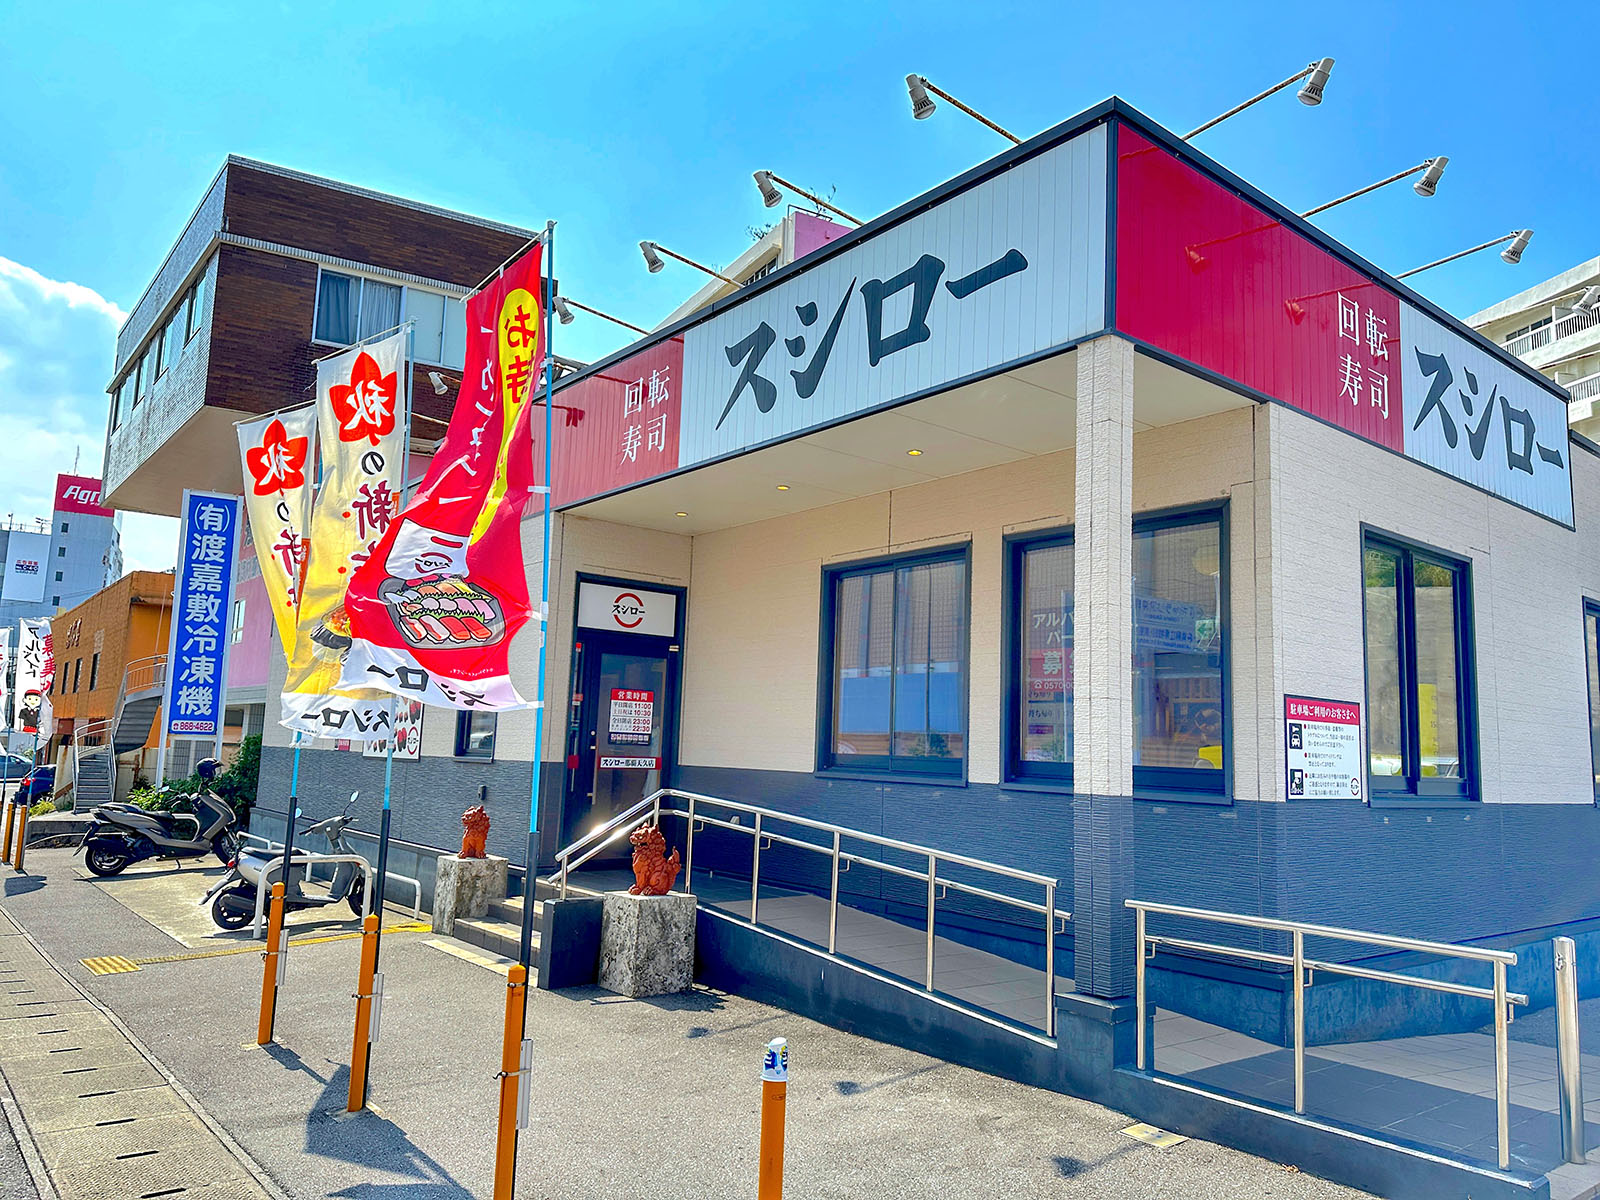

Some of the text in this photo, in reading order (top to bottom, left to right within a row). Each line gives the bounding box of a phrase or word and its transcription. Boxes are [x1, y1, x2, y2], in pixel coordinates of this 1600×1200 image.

[715, 247, 1029, 431] スシロー
[1337, 291, 1389, 361] 回転
[623, 365, 670, 419] 回転
[1338, 353, 1389, 420] 寿司
[1412, 345, 1564, 475] スシロー
[620, 413, 668, 465] 寿司
[62, 485, 101, 504] Agr
[175, 502, 230, 716] (有)渡嘉敷冷凍機
[611, 604, 645, 615] スシロー
[617, 691, 648, 701] 営業時間
